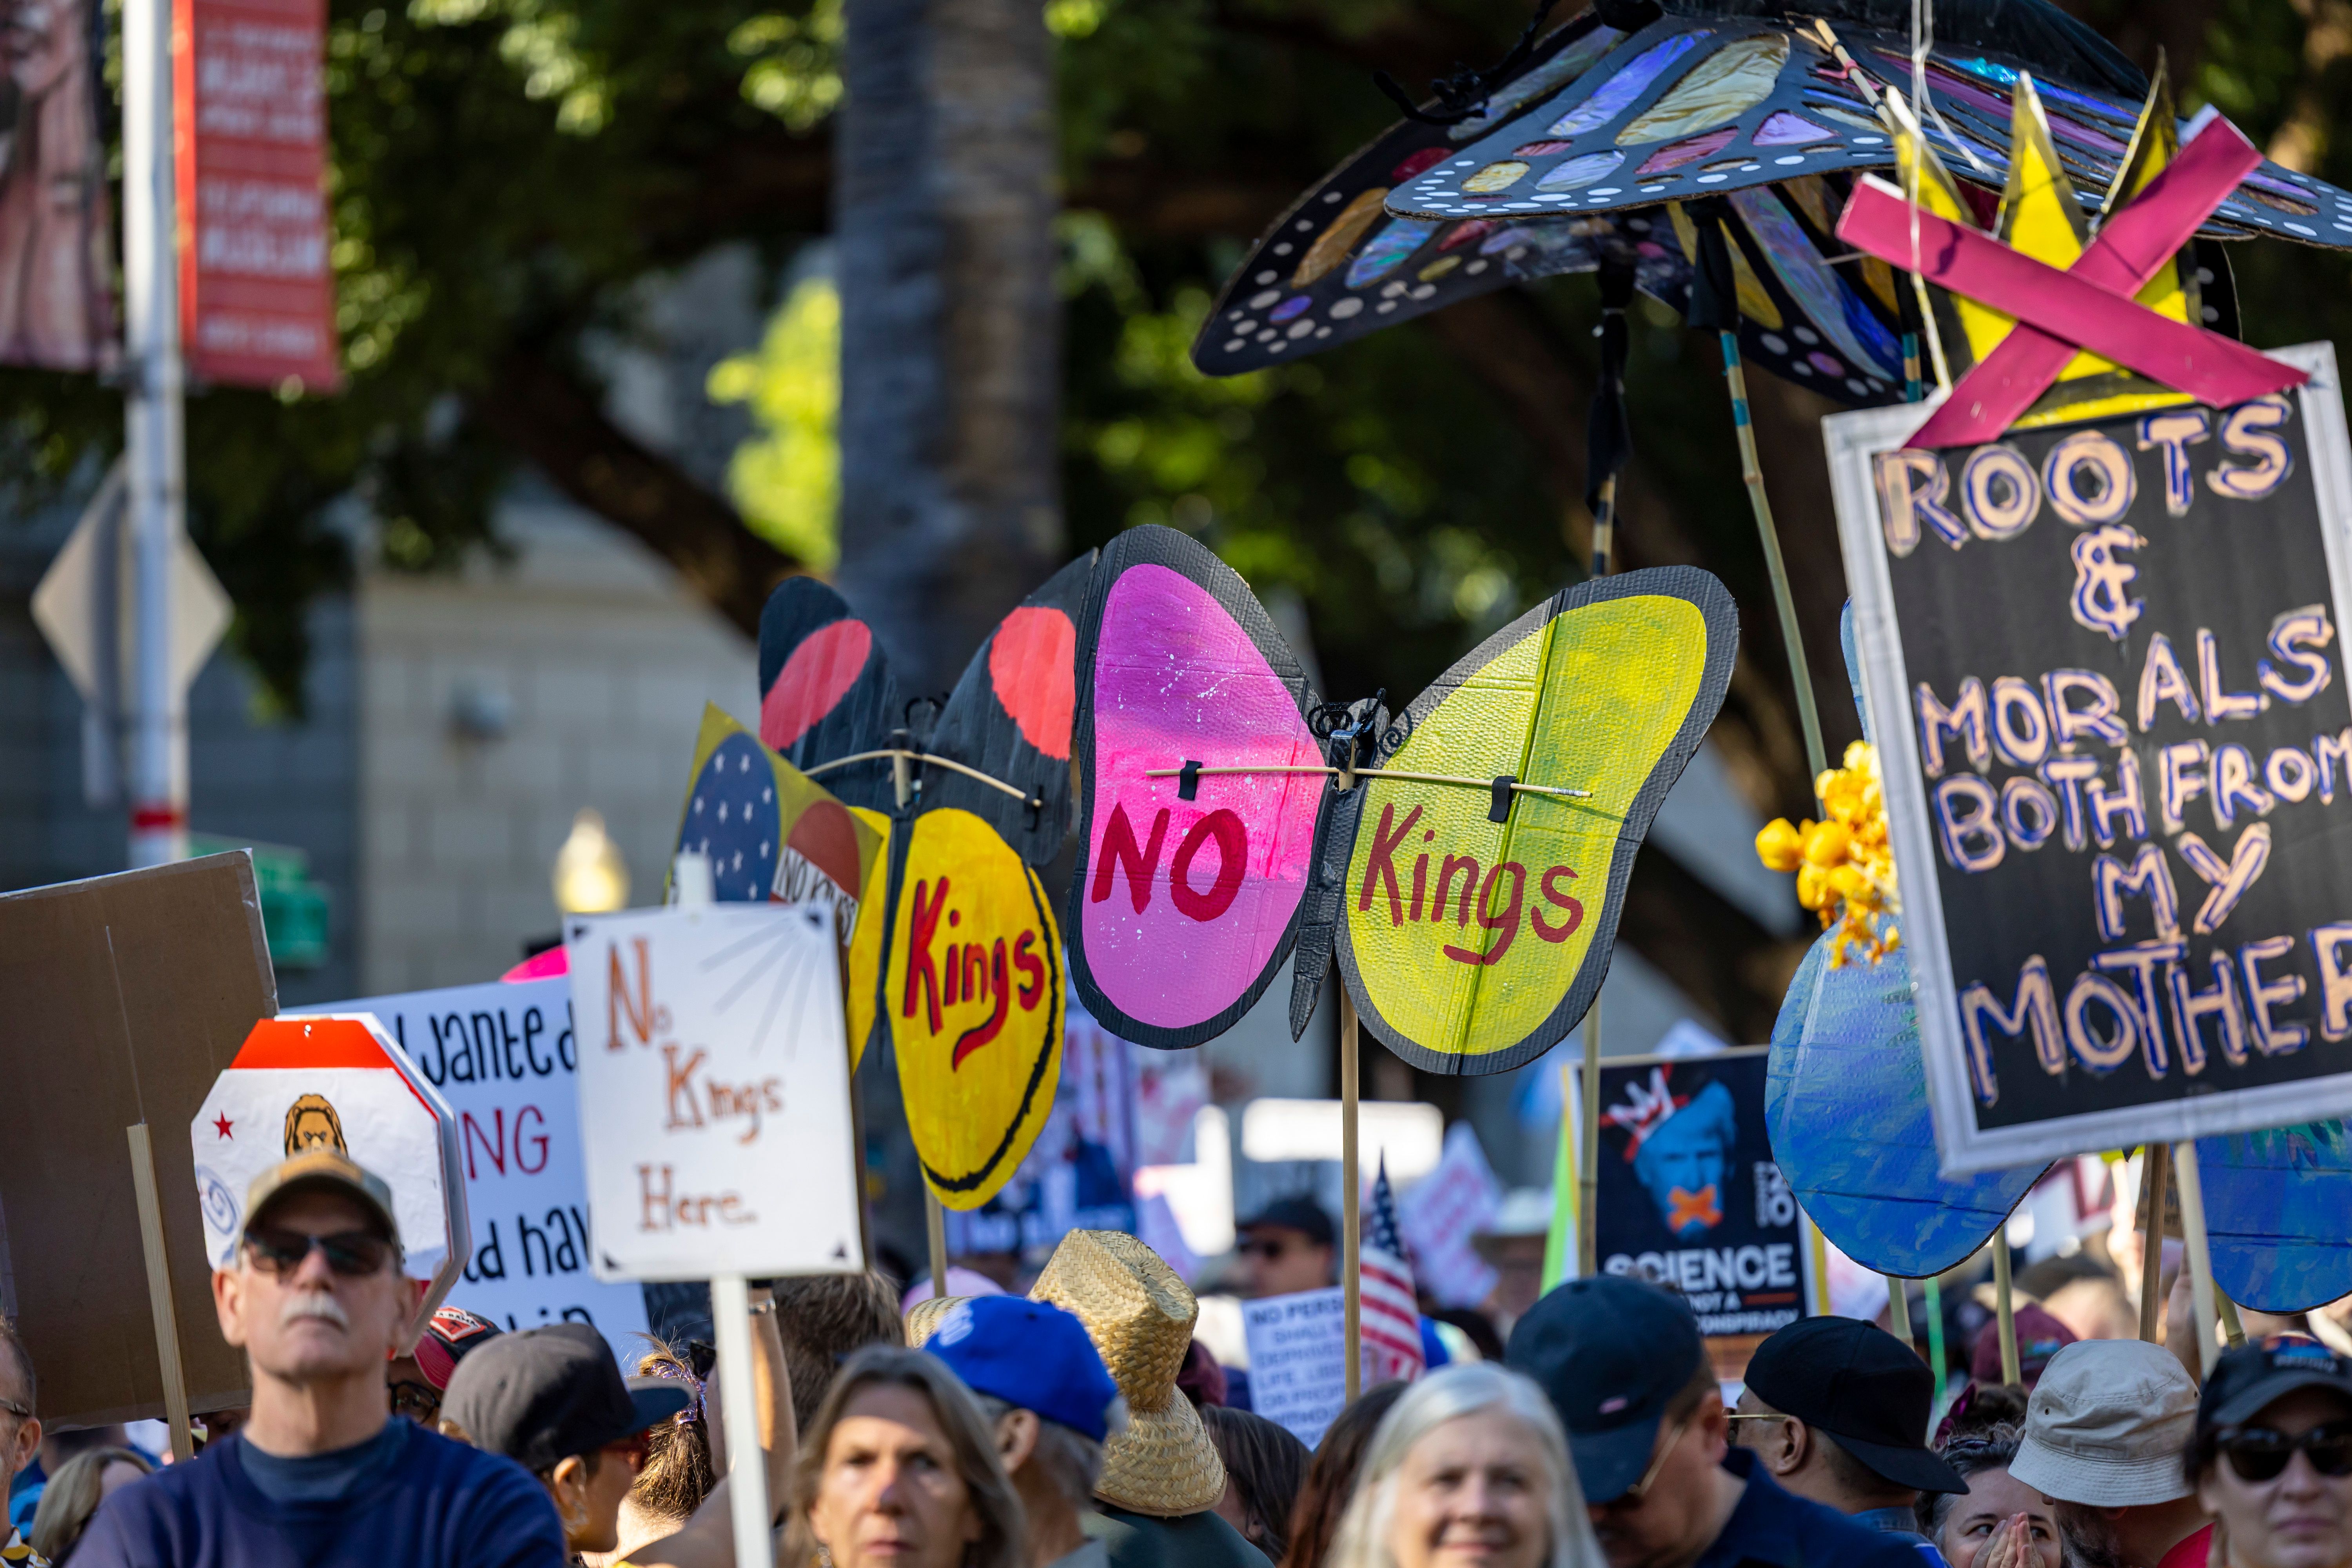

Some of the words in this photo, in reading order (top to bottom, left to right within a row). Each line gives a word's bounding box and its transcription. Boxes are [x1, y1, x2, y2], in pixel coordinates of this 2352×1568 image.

[1873, 393, 2294, 558] ROOTS
[2070, 524, 2148, 641] &
[1915, 604, 2335, 778] MORALS
[1932, 747, 2150, 873] BOTH
[2158, 726, 2352, 836] FROM
[1091, 801, 1248, 922] NO
[1358, 802, 1584, 966] Kings
[2091, 821, 2271, 942] MY
[606, 935, 673, 1052] No
[903, 876, 1045, 1073] Kings
[1958, 919, 2352, 1109] MOTHER
[662, 1043, 783, 1145] Kings
[1604, 1243, 1797, 1290] SCIENCE
